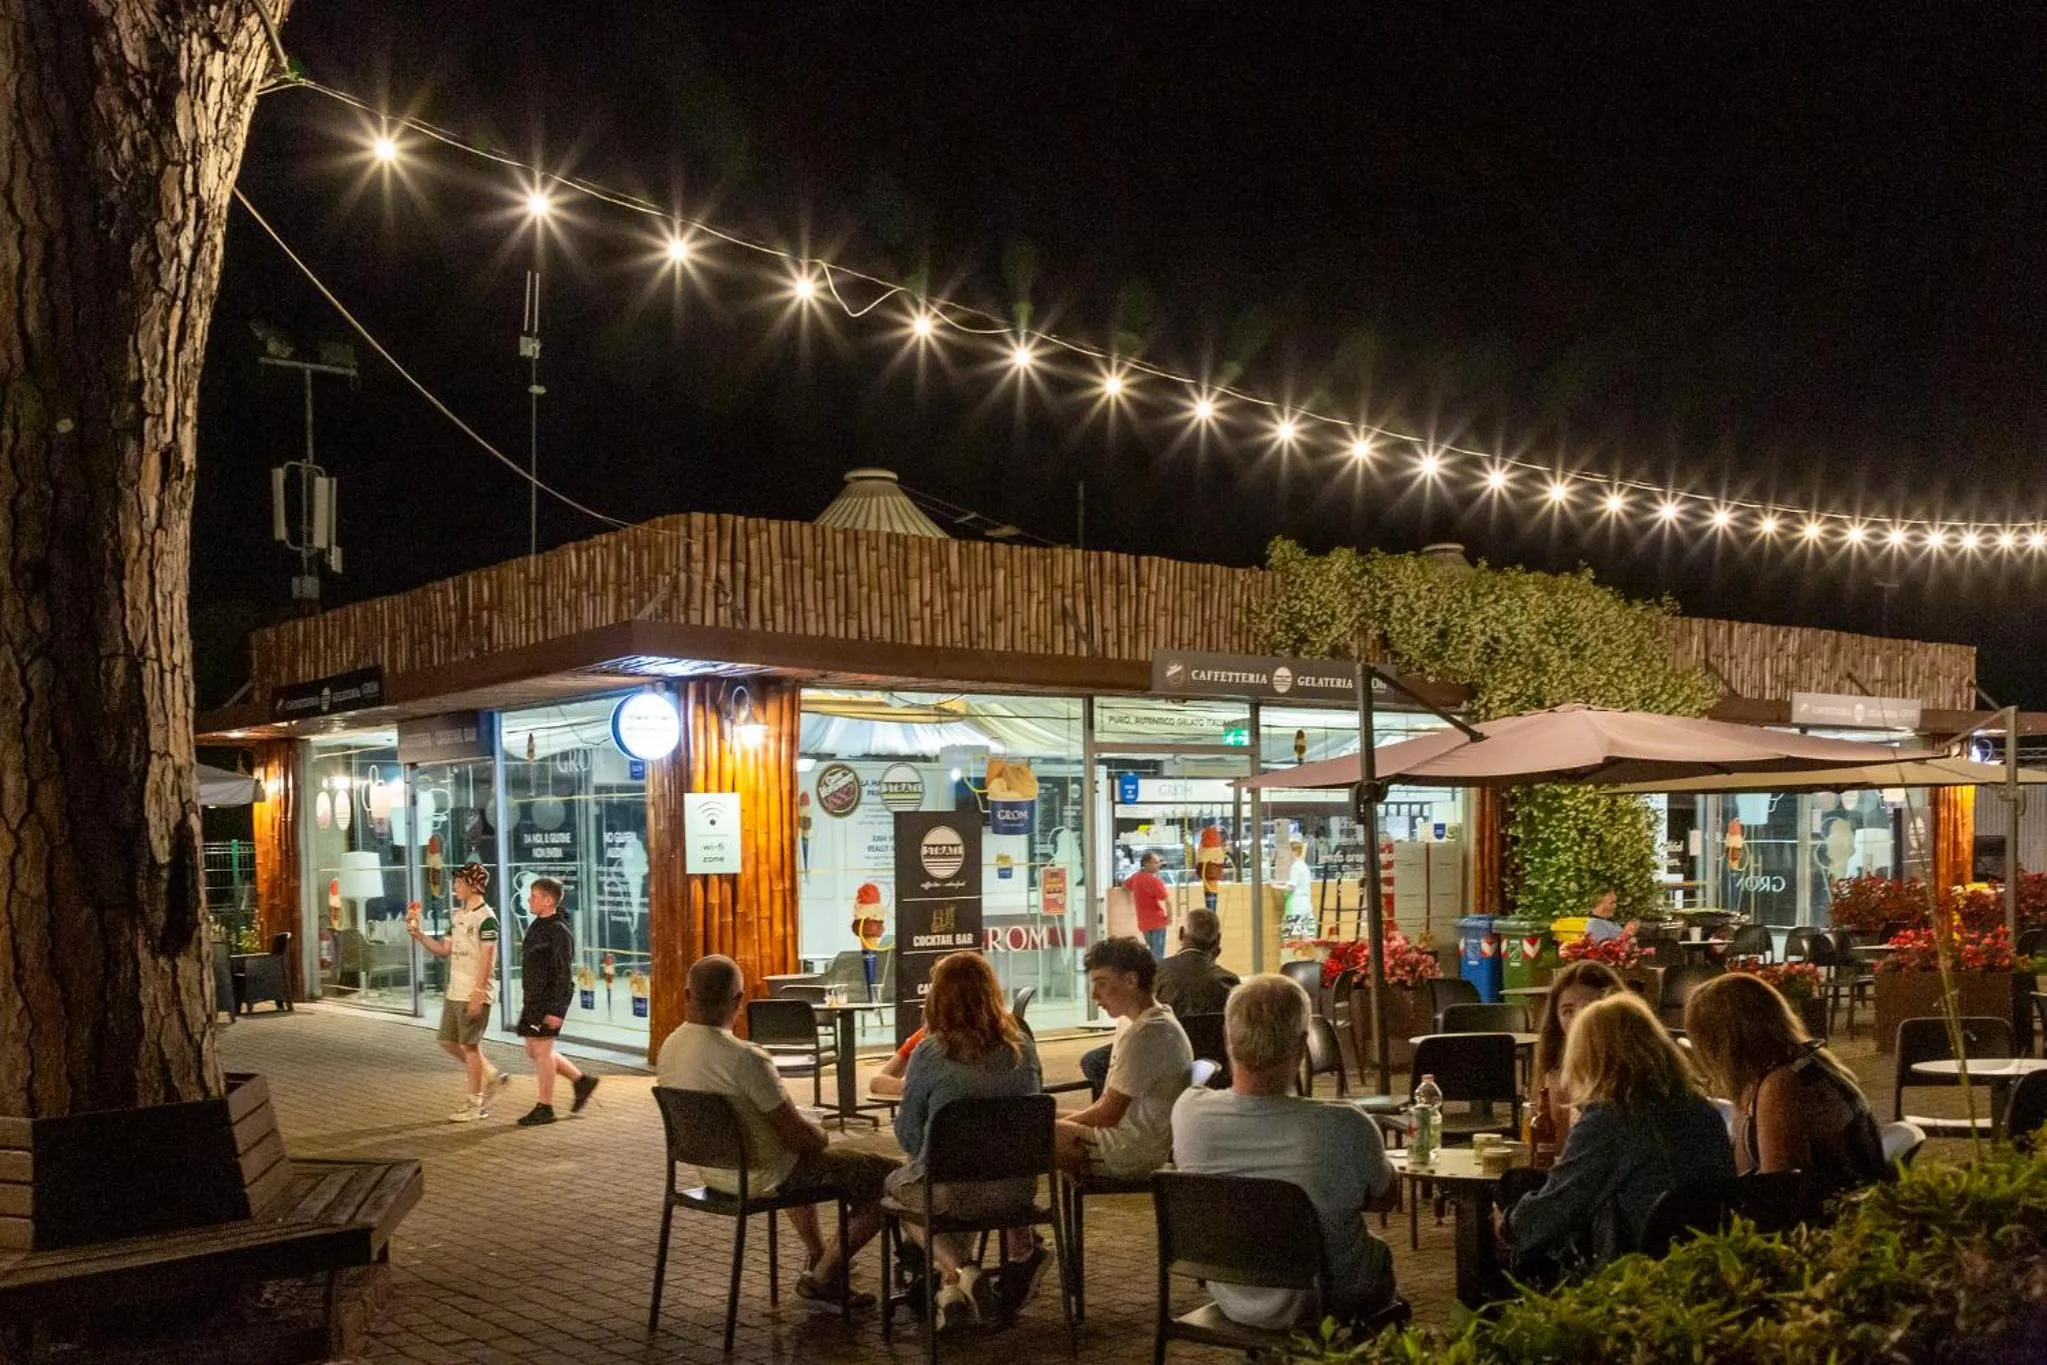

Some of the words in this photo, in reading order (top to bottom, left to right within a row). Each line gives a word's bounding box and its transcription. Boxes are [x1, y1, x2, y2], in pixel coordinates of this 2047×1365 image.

[1191, 669, 1268, 685] CAFFETTERIA
[1297, 675, 1353, 689] GELATERIA
[996, 809, 1029, 820] GROM
[703, 842, 725, 851] wi-fi
[703, 856, 725, 864] zone
[913, 934, 954, 947] COCKTAIL
[955, 932, 974, 945] BAR
